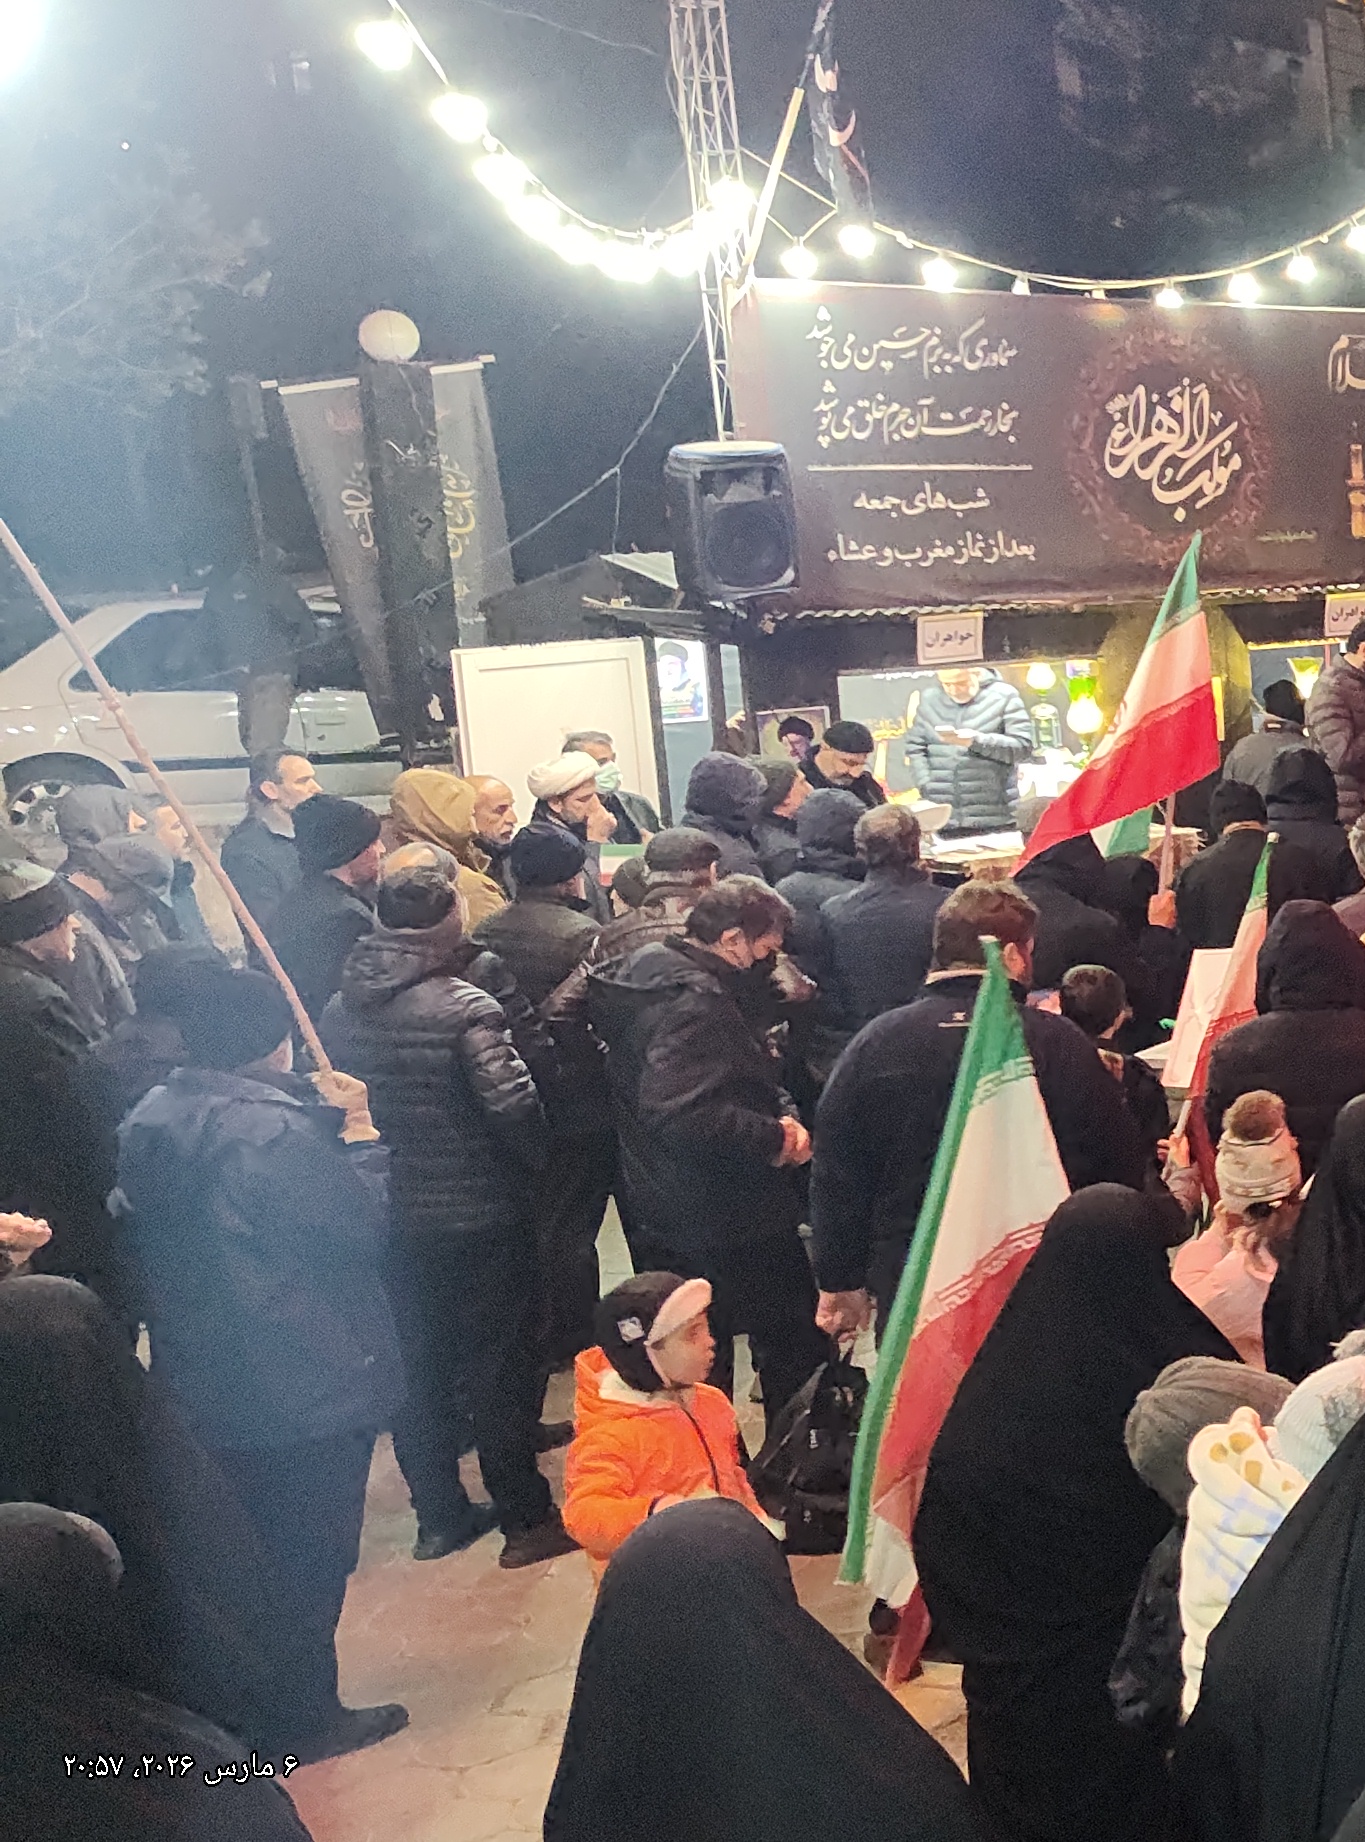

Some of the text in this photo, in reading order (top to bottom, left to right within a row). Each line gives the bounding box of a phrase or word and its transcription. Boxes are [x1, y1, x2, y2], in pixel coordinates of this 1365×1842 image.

[853, 326, 932, 375] حسین
[850, 393, 888, 441] خلق
[882, 402, 912, 446] جرم
[900, 396, 935, 439] آن
[852, 491, 903, 519] جمعه
[875, 546, 894, 567] و
[893, 539, 954, 567] مغرب
[953, 531, 986, 565] نماز
[983, 531, 1005, 564] از
[1004, 538, 1037, 562] بعد
